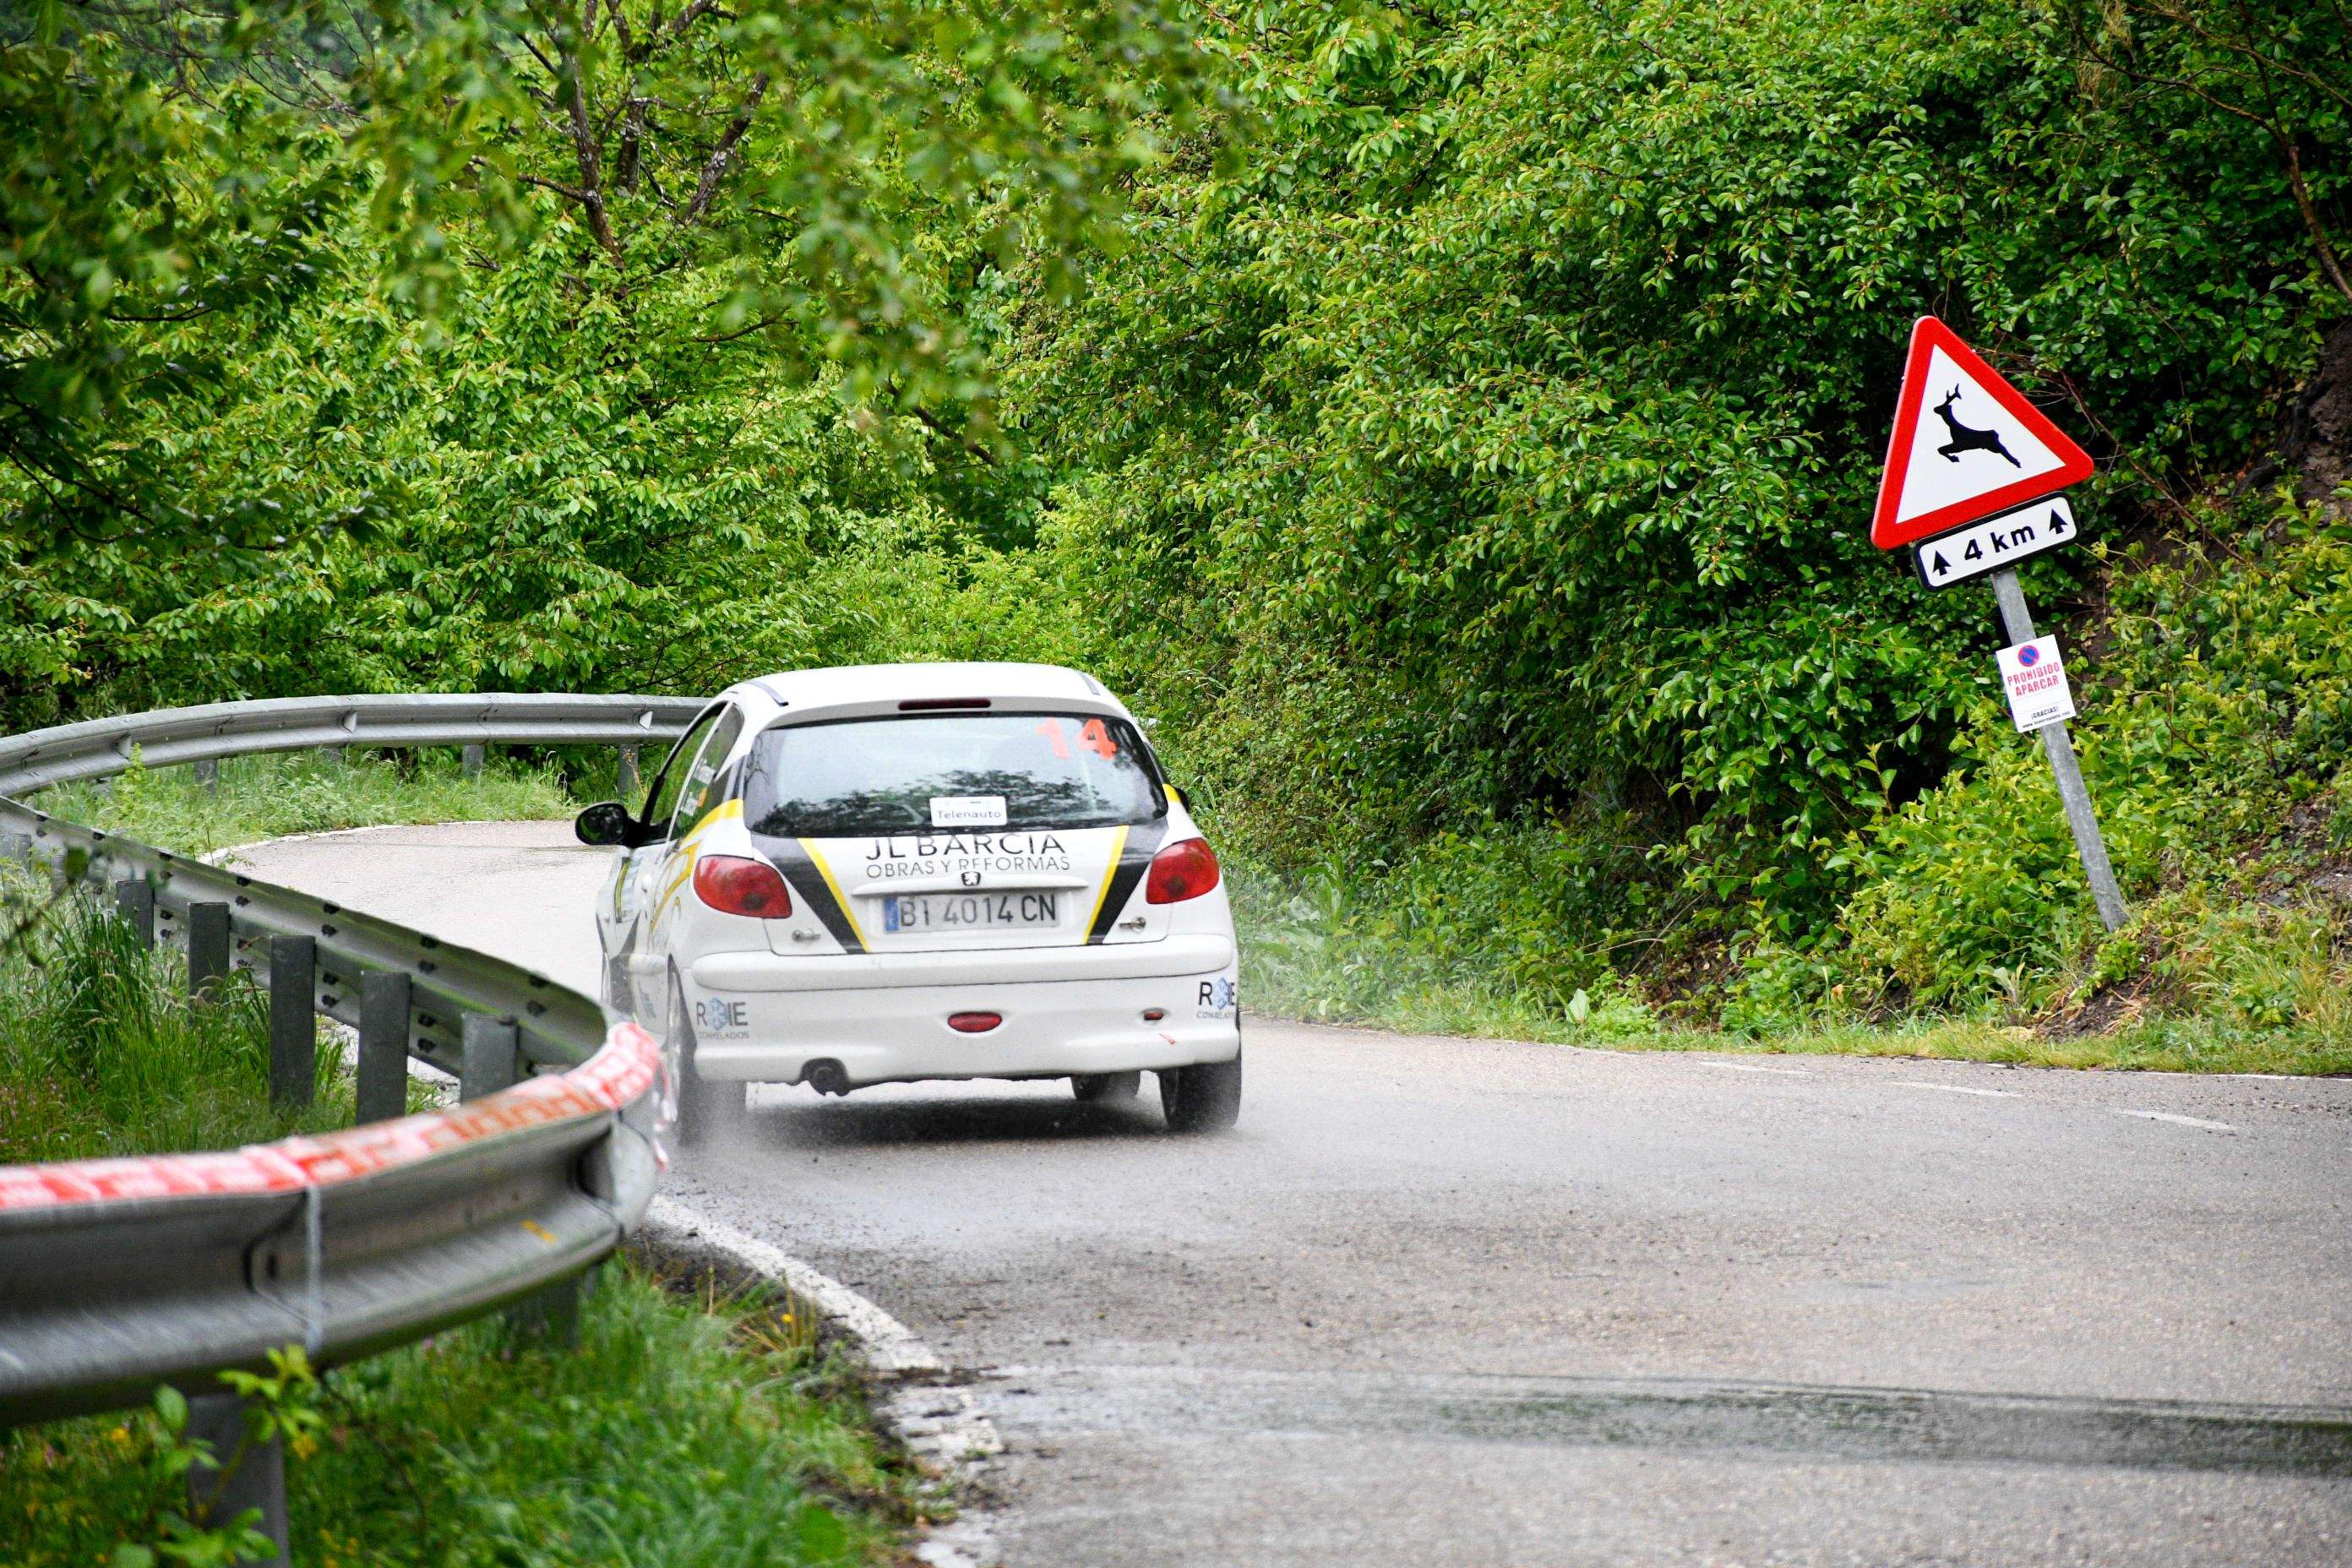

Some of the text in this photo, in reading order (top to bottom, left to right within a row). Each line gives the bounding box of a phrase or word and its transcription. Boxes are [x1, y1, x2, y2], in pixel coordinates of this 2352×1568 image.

[1964, 525, 2035, 560] 4 km
[2006, 662, 2060, 686] PROHIBIDO
[2015, 674, 2059, 696] APARCAR
[1036, 716, 1118, 760] 14
[866, 834, 1066, 860] JL BARCIA
[867, 856, 1070, 879] OBRAS Y REFORMAS
[901, 894, 1056, 927] BI 4014 CN
